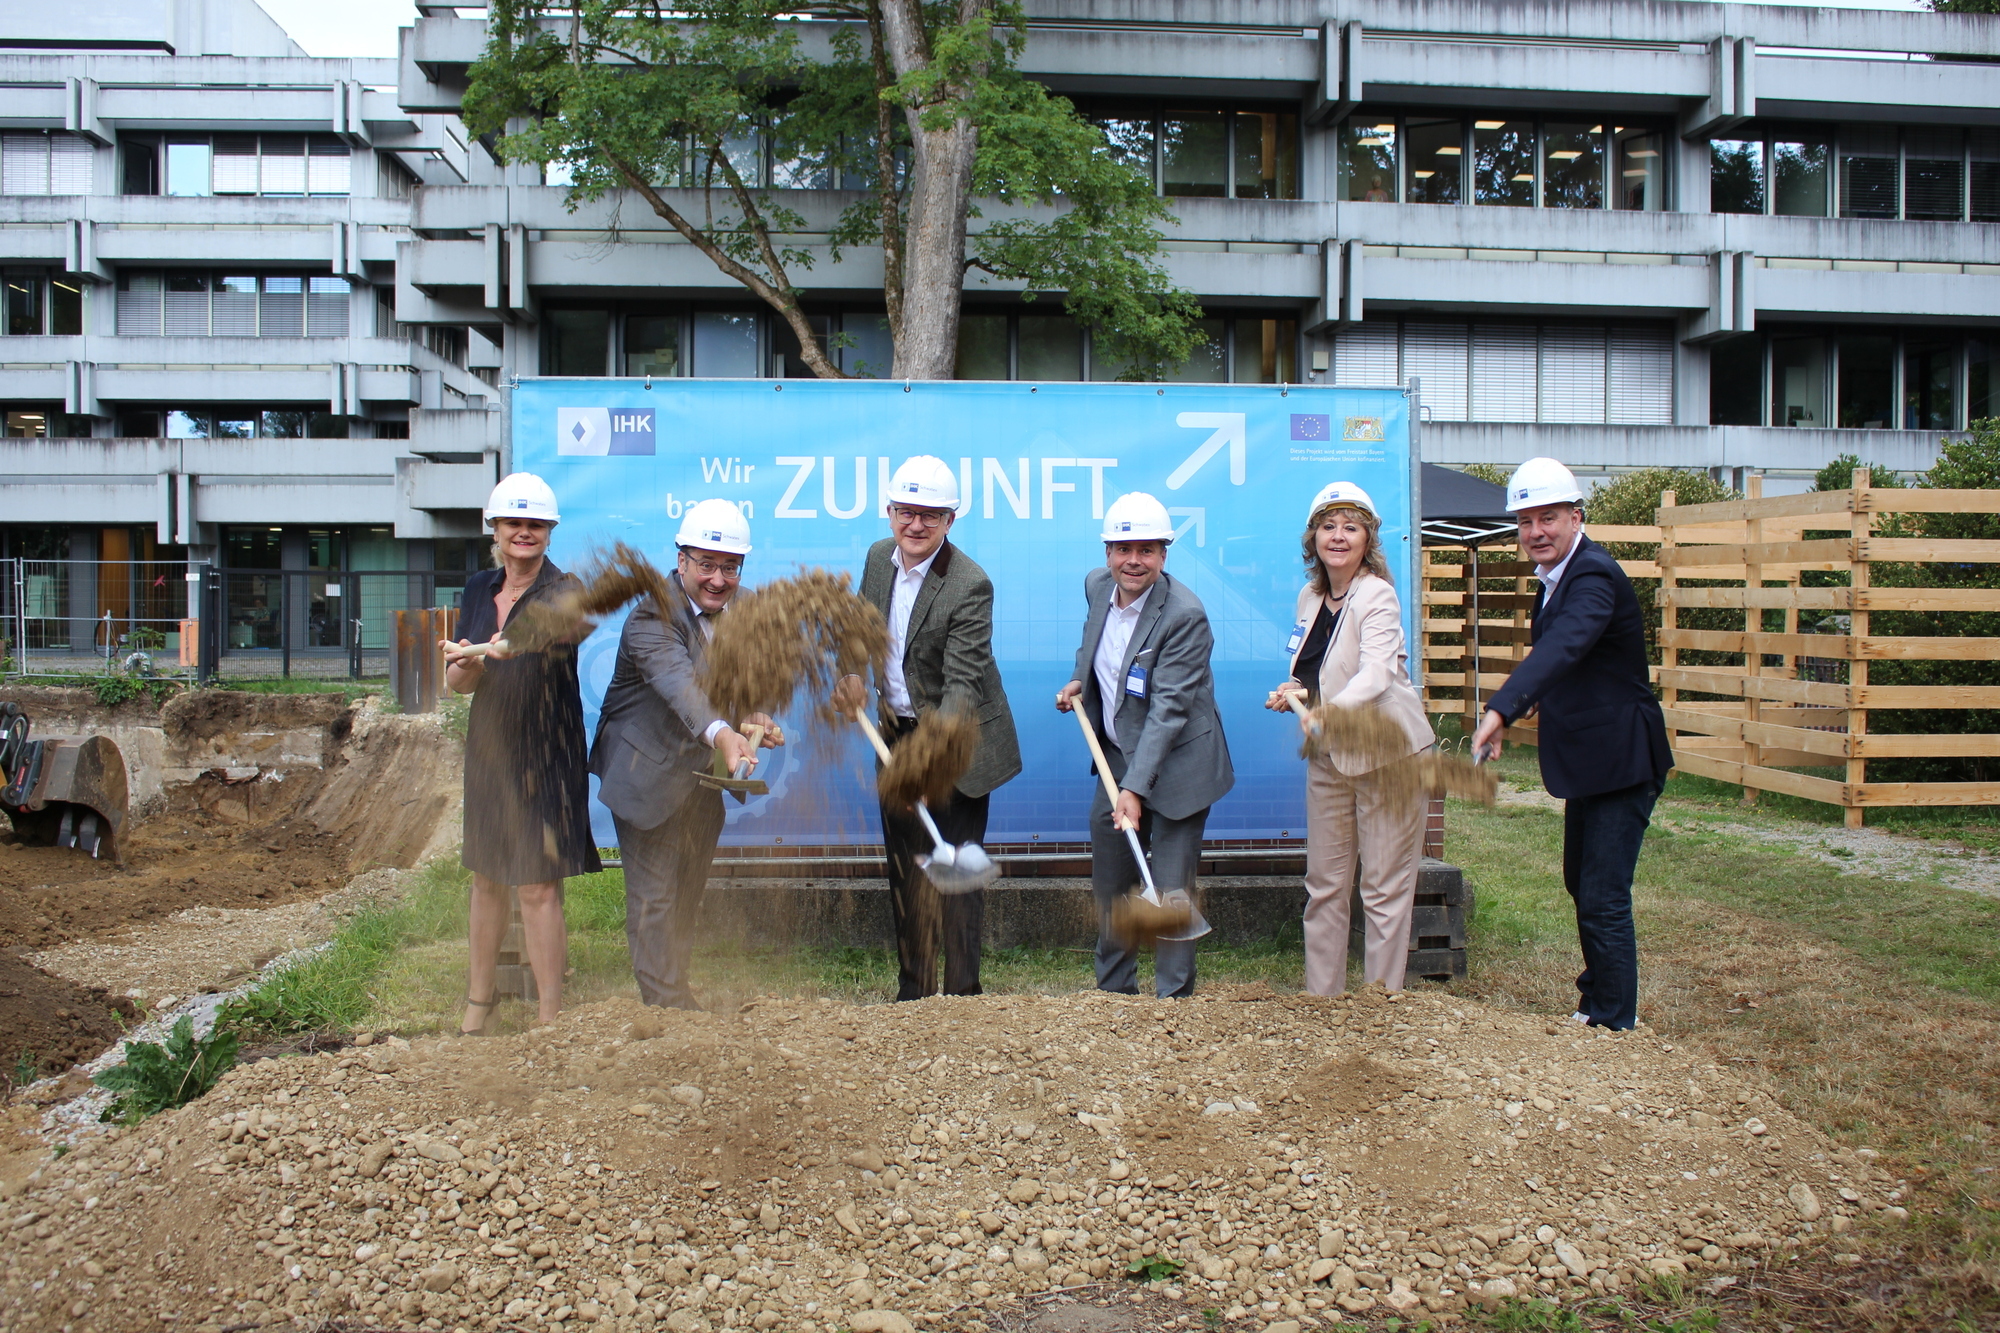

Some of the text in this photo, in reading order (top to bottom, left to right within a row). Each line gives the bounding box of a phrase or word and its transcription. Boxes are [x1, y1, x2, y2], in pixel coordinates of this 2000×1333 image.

[614, 415, 652, 433] IHK
[701, 457, 755, 483] Wir
[774, 456, 1118, 519] ZUNFT
[666, 493, 754, 519] ban
